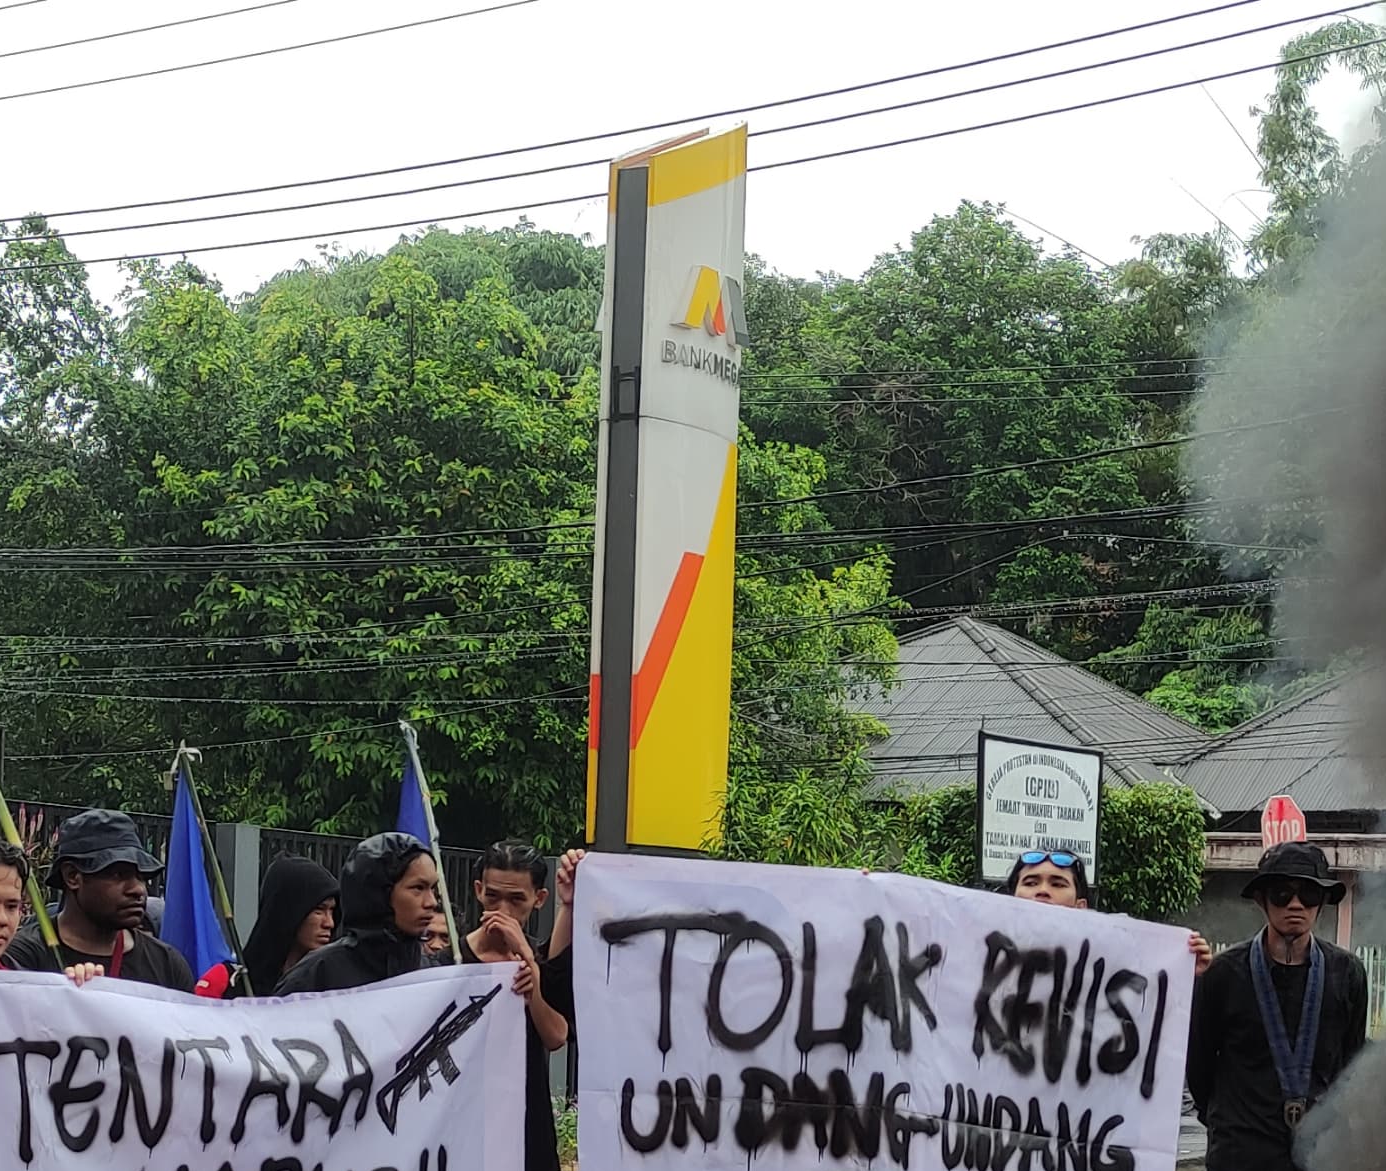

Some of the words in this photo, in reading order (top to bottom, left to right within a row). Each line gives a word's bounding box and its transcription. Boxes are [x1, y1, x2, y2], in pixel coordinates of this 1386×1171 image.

[1003, 753, 1032, 775] PROTESTAN
[1038, 753, 1065, 772] INDONESIA
[995, 798, 1021, 816] JEMAAT
[1265, 819, 1301, 848] STOP
[600, 911, 942, 1058] TOLAK
[972, 929, 1169, 1100] REVISI
